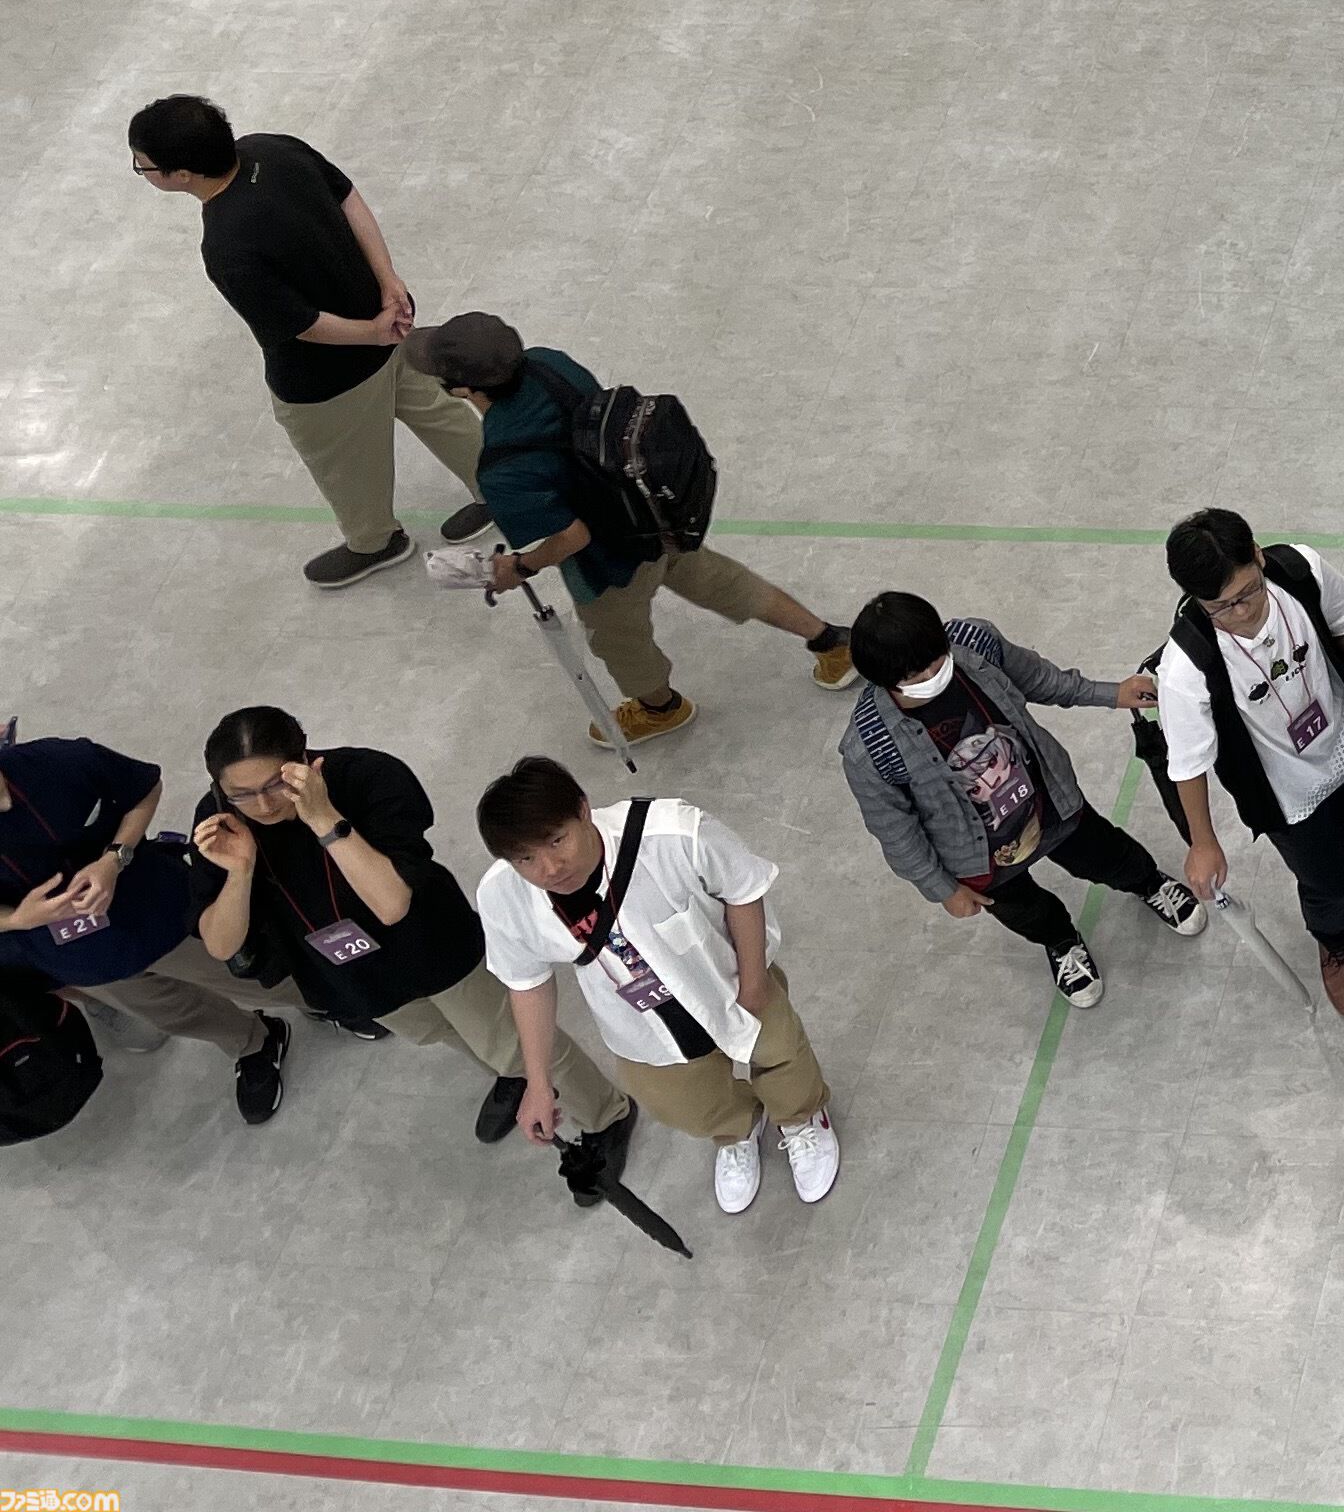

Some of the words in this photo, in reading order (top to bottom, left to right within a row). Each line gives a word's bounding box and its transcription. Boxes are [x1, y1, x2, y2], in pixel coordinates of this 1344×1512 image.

[1296, 737, 1306, 749] E
[1306, 715, 1322, 737] 17
[1000, 804, 1009, 816] E
[1009, 784, 1029, 804] 18
[60, 928, 72, 939] E
[73, 914, 98, 934] 21
[334, 949, 348, 961] E
[345, 938, 370, 955] 20
[636, 999, 650, 1010] E
